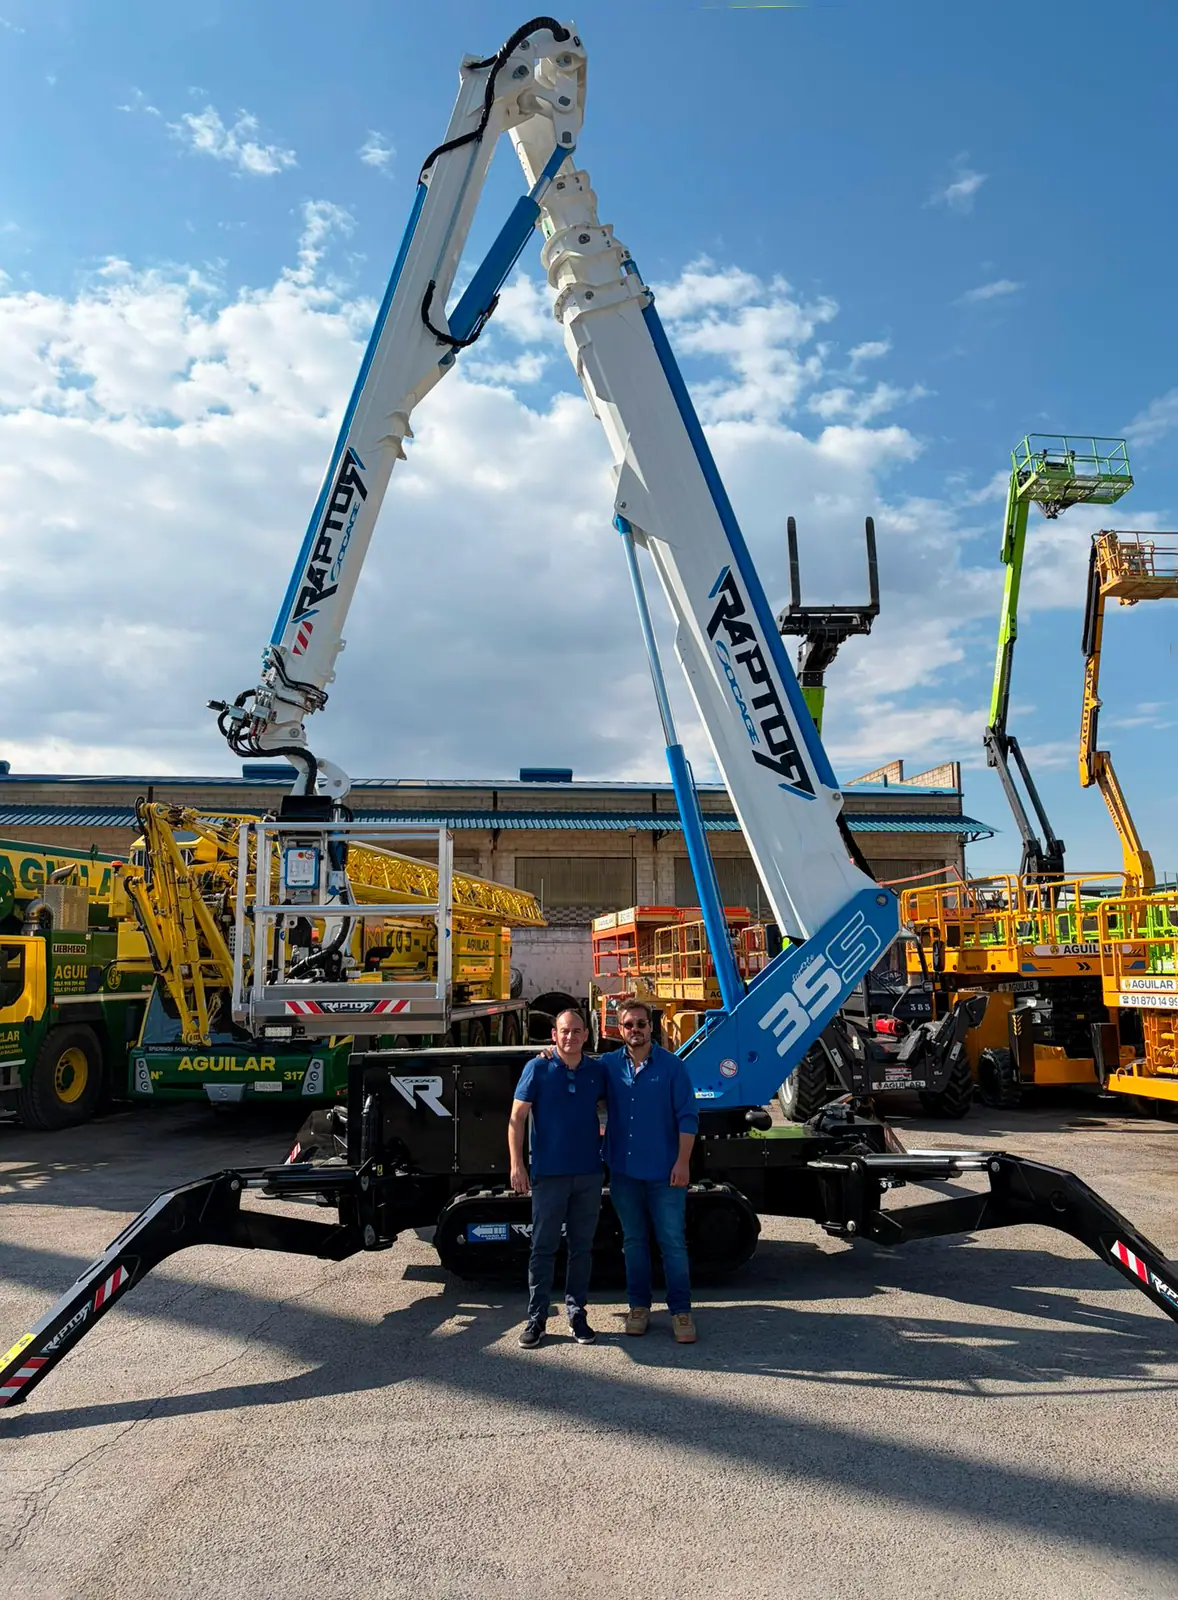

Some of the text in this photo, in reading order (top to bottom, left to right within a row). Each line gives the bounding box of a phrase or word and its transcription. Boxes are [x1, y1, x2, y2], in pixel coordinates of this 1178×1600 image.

[53, 944, 86, 953] LIEBHERR
[466, 938, 489, 951] AGUILAR
[1008, 981, 1034, 992] AGUILAR
[1132, 980, 1173, 989] AGUILAR
[178, 1056, 276, 1071] AGUILAR
[283, 1071, 305, 1081] 317
